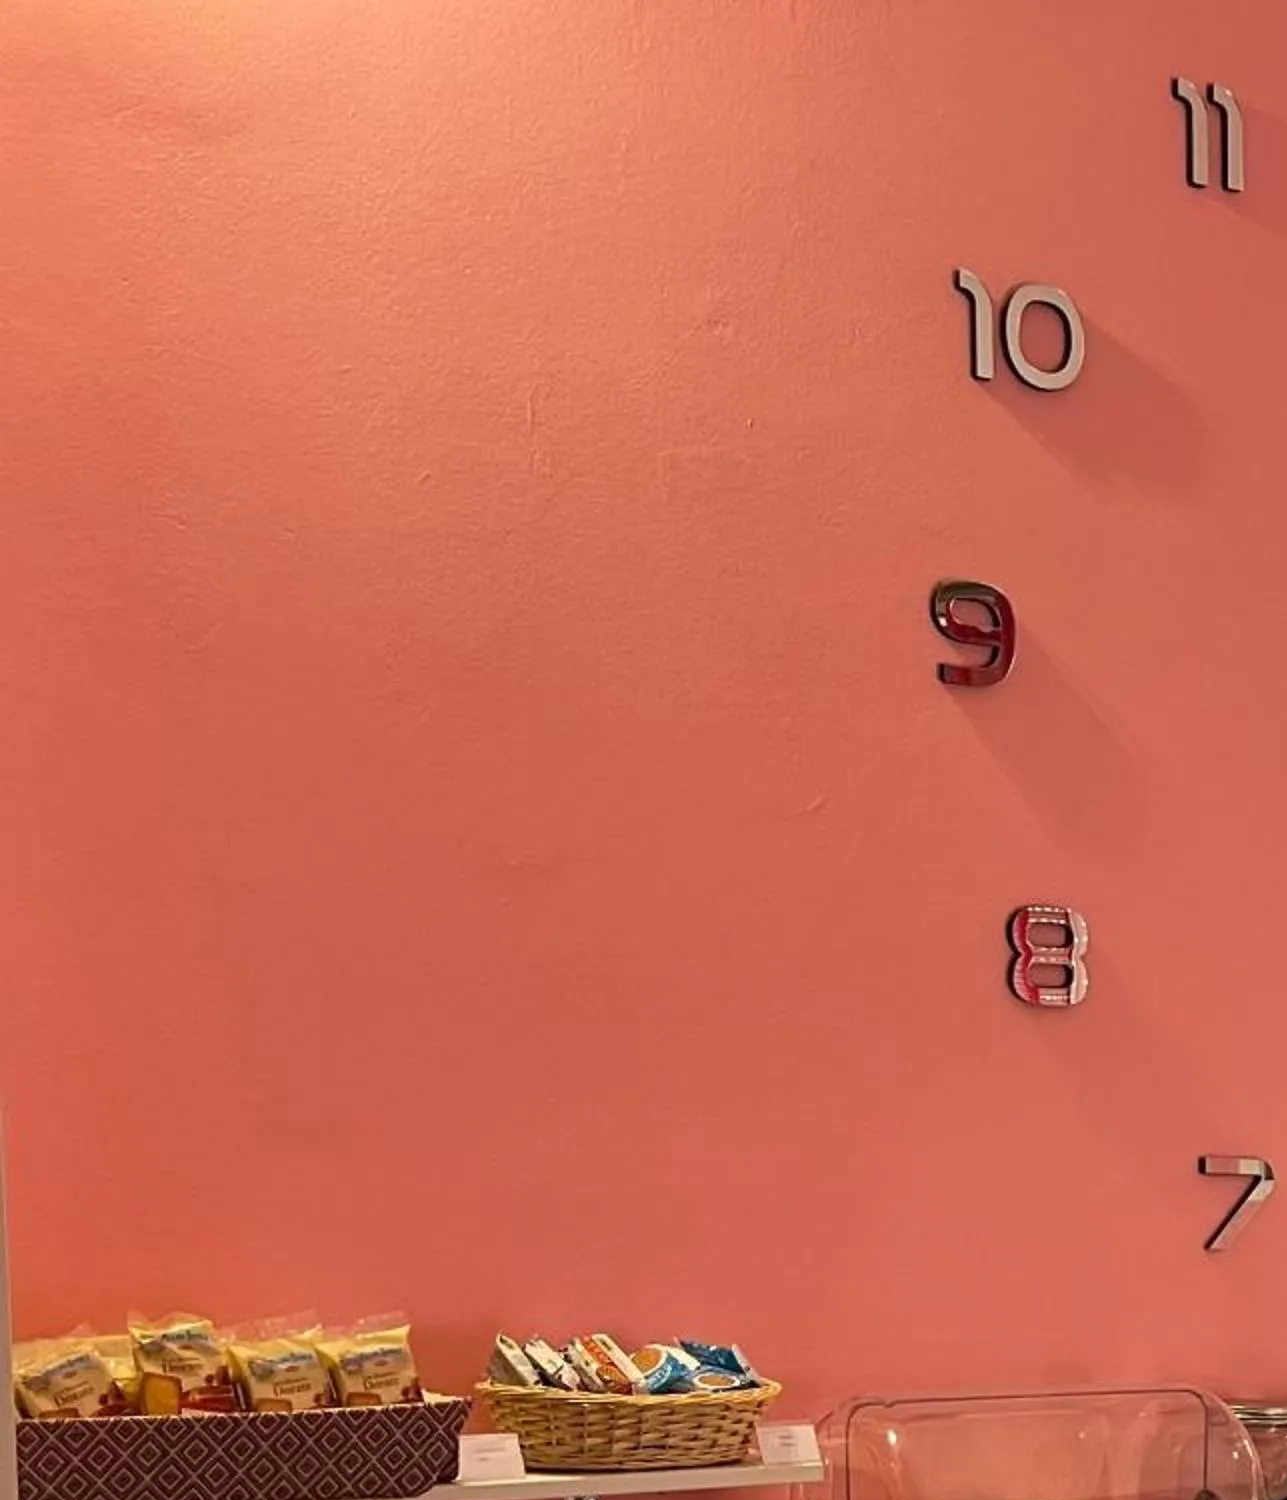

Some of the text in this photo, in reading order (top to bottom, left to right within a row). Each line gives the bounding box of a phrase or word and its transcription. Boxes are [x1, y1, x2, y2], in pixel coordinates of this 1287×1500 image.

[1172, 75, 1245, 192] 11
[953, 266, 1087, 393] 10
[930, 578, 1018, 689] 9
[1006, 903, 1090, 1008] 8
[1197, 1154, 1275, 1253] 7
